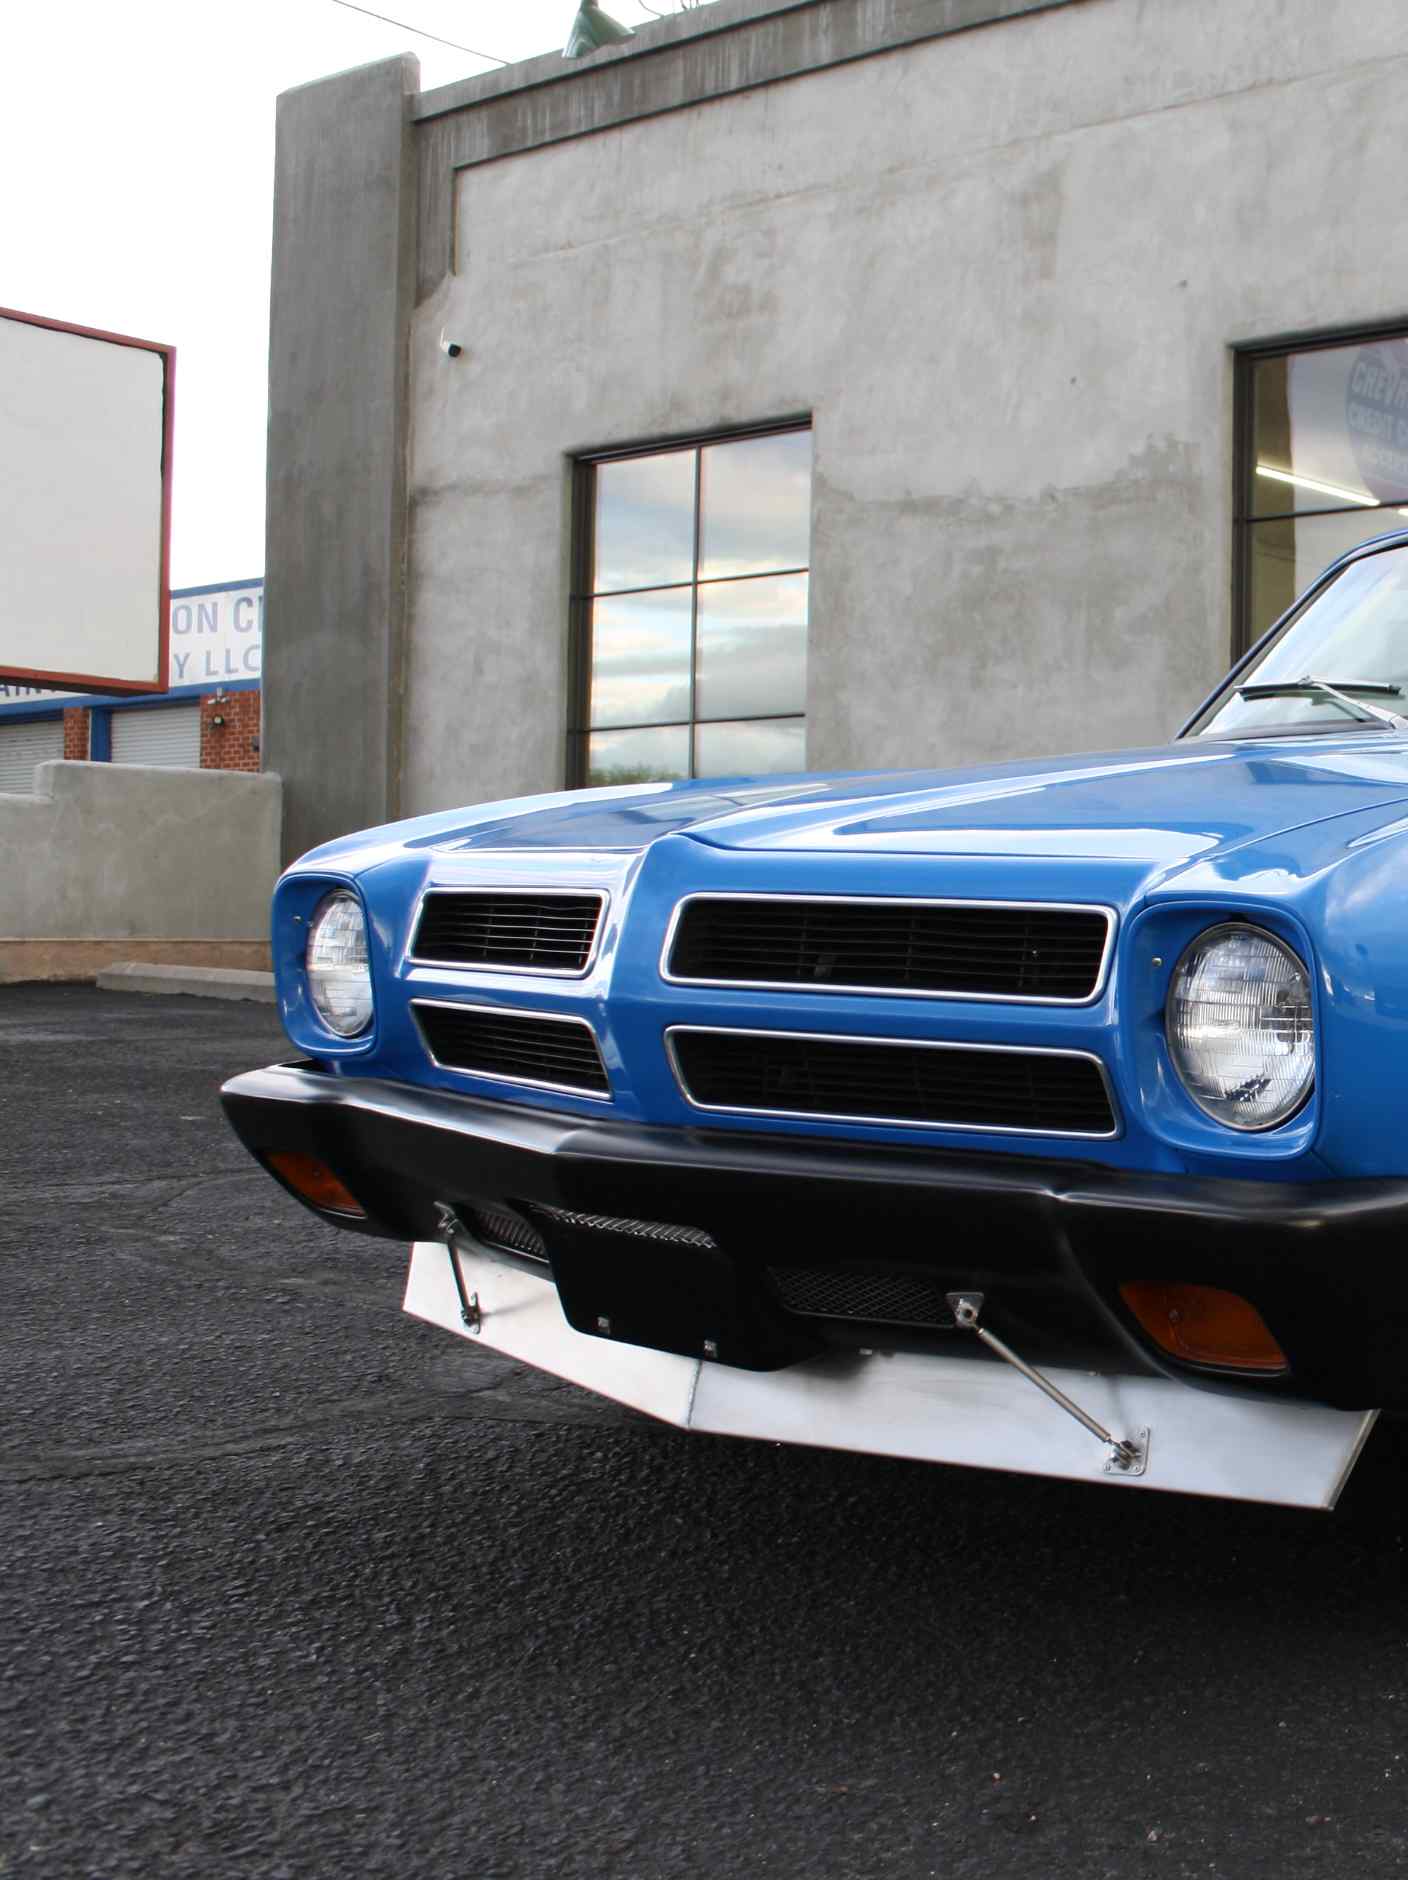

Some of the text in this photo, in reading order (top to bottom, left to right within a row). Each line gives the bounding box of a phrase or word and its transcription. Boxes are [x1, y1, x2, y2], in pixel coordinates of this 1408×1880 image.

[172, 601, 218, 634] ON
[173, 644, 261, 678] Y LLC
